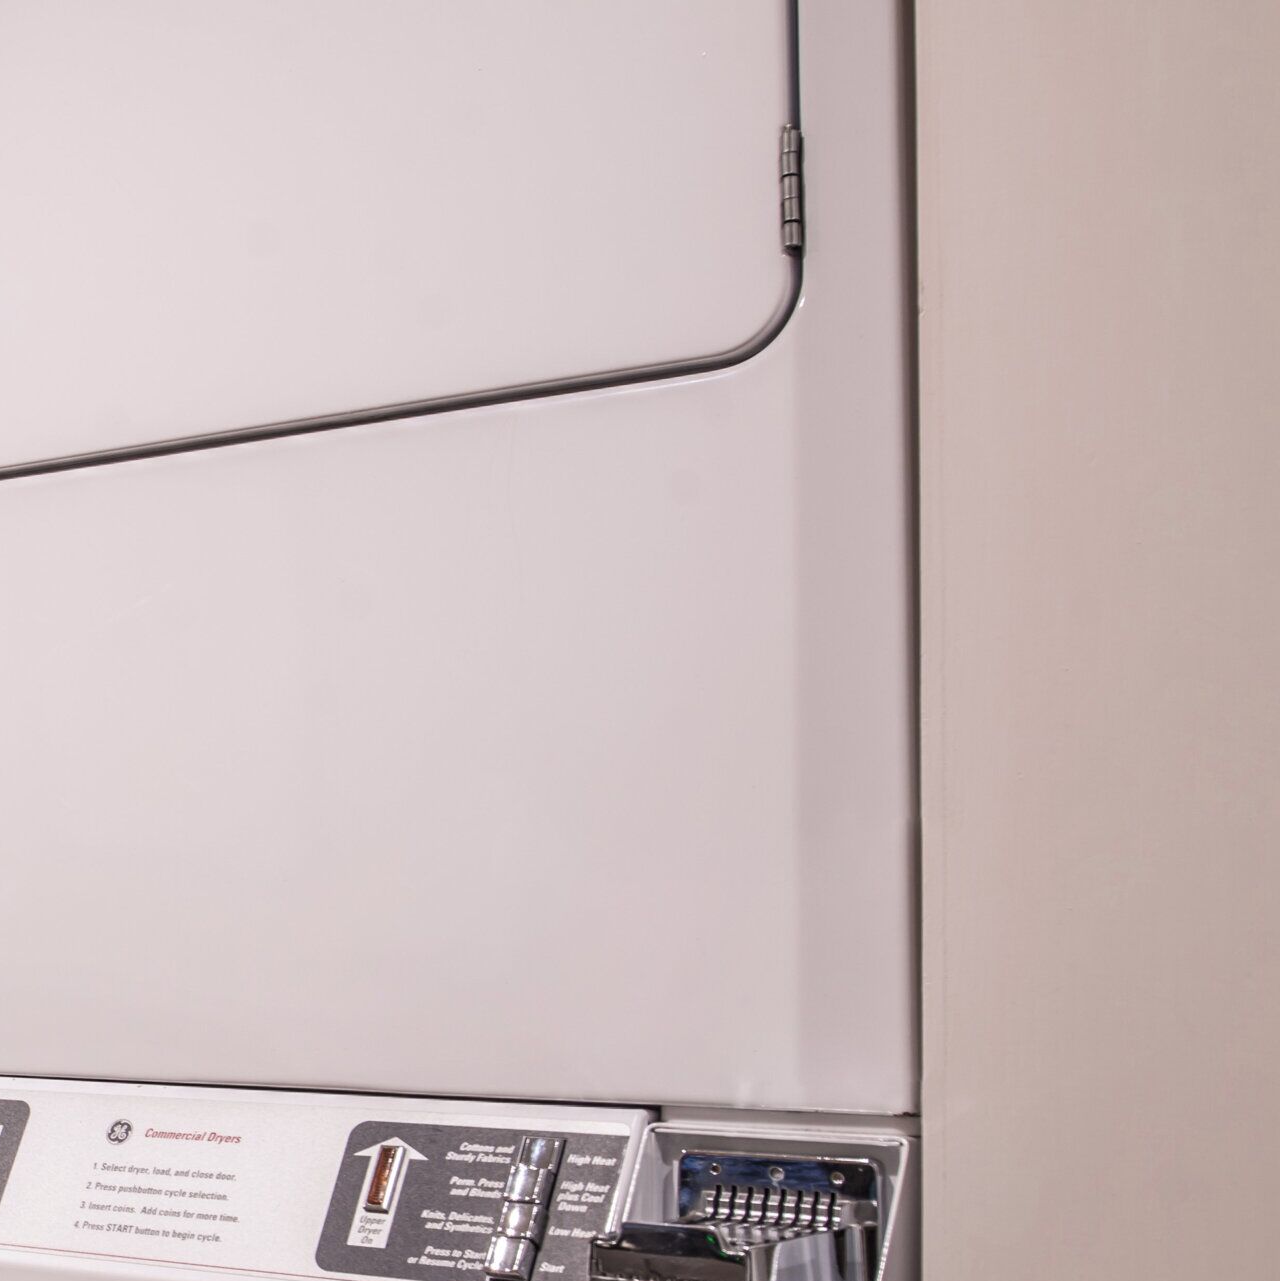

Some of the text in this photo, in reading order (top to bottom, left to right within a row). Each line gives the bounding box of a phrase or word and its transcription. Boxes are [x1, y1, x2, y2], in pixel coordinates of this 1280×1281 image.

[145, 1128, 205, 1142] Commercial
[208, 1132, 242, 1144] Dryers
[458, 1141, 516, 1154] Cottons and
[445, 1151, 512, 1164] Sturdy Fabrics
[567, 1154, 617, 1166] High Heat
[101, 1162, 127, 1172] Select
[128, 1165, 151, 1175] dryer,
[153, 1166, 172, 1176] load,
[174, 1168, 190, 1177] and
[192, 1170, 214, 1179] close
[215, 1172, 237, 1181] door.
[449, 1175, 506, 1189] Perm. Press
[560, 1180, 611, 1193] High Heat
[95, 1182, 117, 1191] Press
[118, 1184, 163, 1195] pushbutton
[164, 1189, 187, 1198] cycle
[189, 1190, 229, 1201] selection.
[449, 1187, 503, 1199] and Blends
[556, 1192, 606, 1203] plus Cool
[88, 1202, 112, 1211] Insert
[113, 1204, 136, 1213] coins.
[140, 1206, 157, 1216] Add
[158, 1207, 181, 1218] coins
[182, 1210, 195, 1219] for
[197, 1212, 218, 1221] more
[219, 1214, 240, 1223] time.
[557, 1201, 589, 1213] Down
[360, 1215, 387, 1226] Upper
[420, 1209, 447, 1220] Knits,
[82, 1221, 104, 1231] Press
[106, 1223, 133, 1234] START
[135, 1226, 160, 1237] button
[161, 1229, 170, 1237] to
[172, 1230, 195, 1241] begin
[197, 1233, 222, 1243] cycle.
[357, 1226, 383, 1235] Dryer
[424, 1220, 494, 1234] and Synthetics
[548, 1226, 597, 1239] Low Heat
[361, 1236, 373, 1245] On
[424, 1245, 452, 1256] Press
[451, 1248, 463, 1257] to
[407, 1256, 419, 1264] or
[418, 1255, 456, 1268] Resume
[539, 1261, 566, 1274] Start
